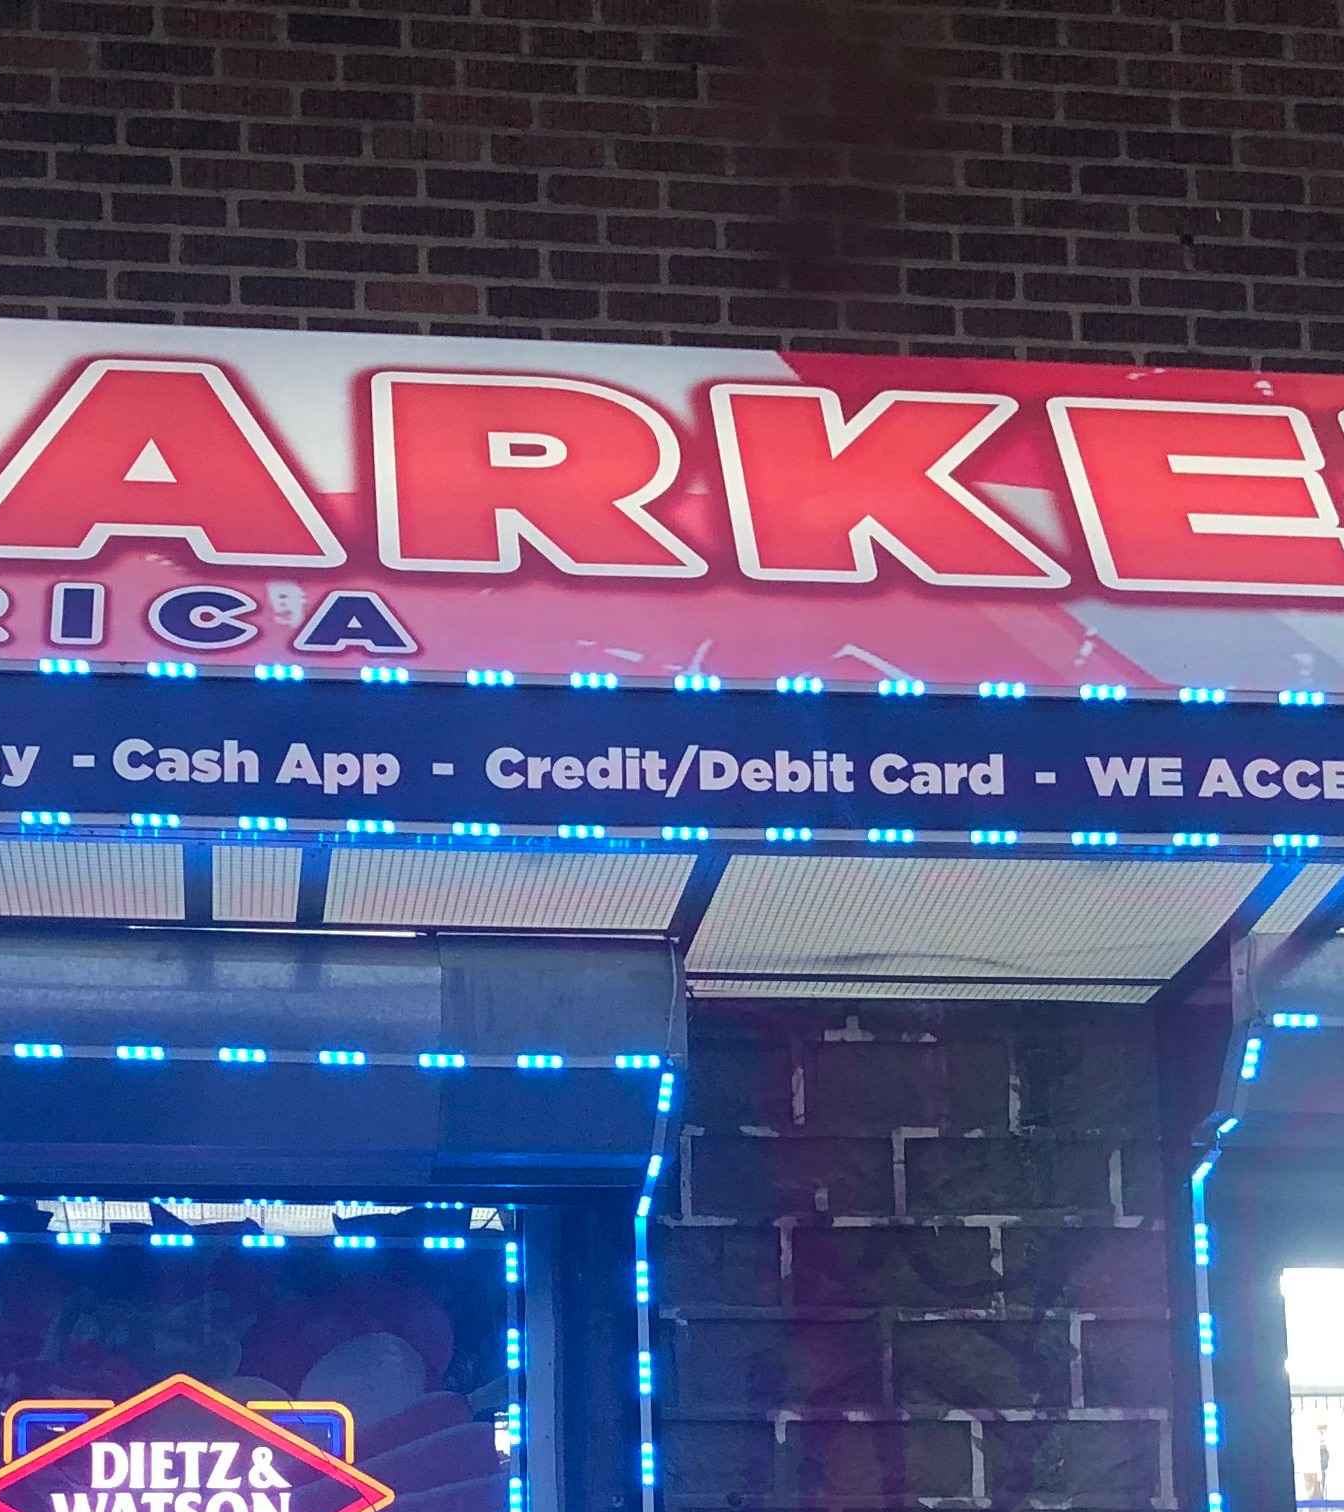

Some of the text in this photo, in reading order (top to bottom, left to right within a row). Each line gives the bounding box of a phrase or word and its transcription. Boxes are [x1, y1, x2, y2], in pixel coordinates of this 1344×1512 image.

[113, 739, 259, 784] Cash
[275, 742, 401, 798] App
[485, 743, 855, 797] Credit/Debit
[869, 753, 1005, 797] Card
[1086, 757, 1183, 799] WE
[90, 1441, 293, 1489] DIETZ &
